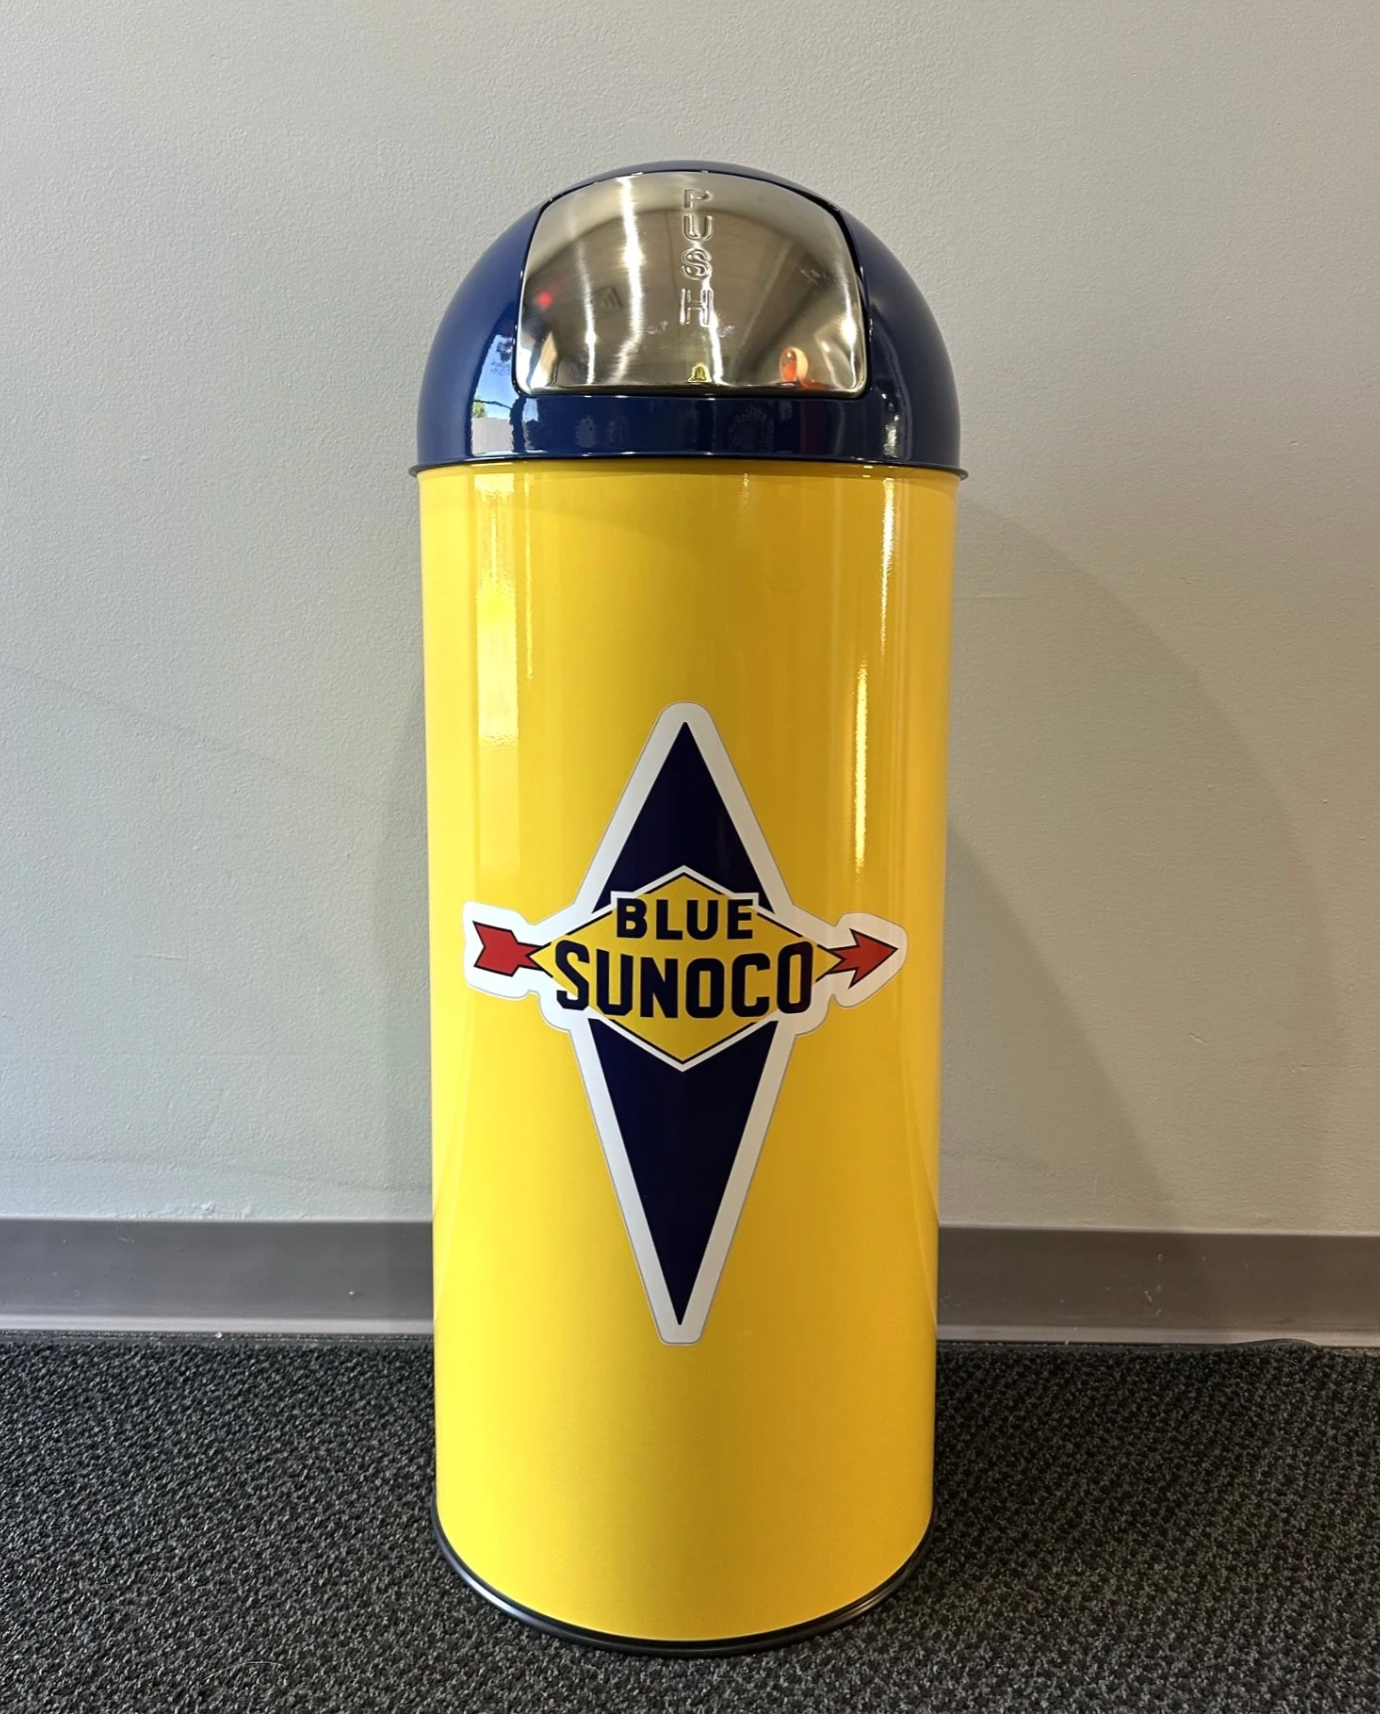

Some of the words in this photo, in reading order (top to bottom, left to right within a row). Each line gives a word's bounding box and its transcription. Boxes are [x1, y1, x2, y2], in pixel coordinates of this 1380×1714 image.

[680, 188, 714, 327] PUSH
[616, 897, 753, 940] BLUE
[555, 939, 814, 1019] SUNOCO
